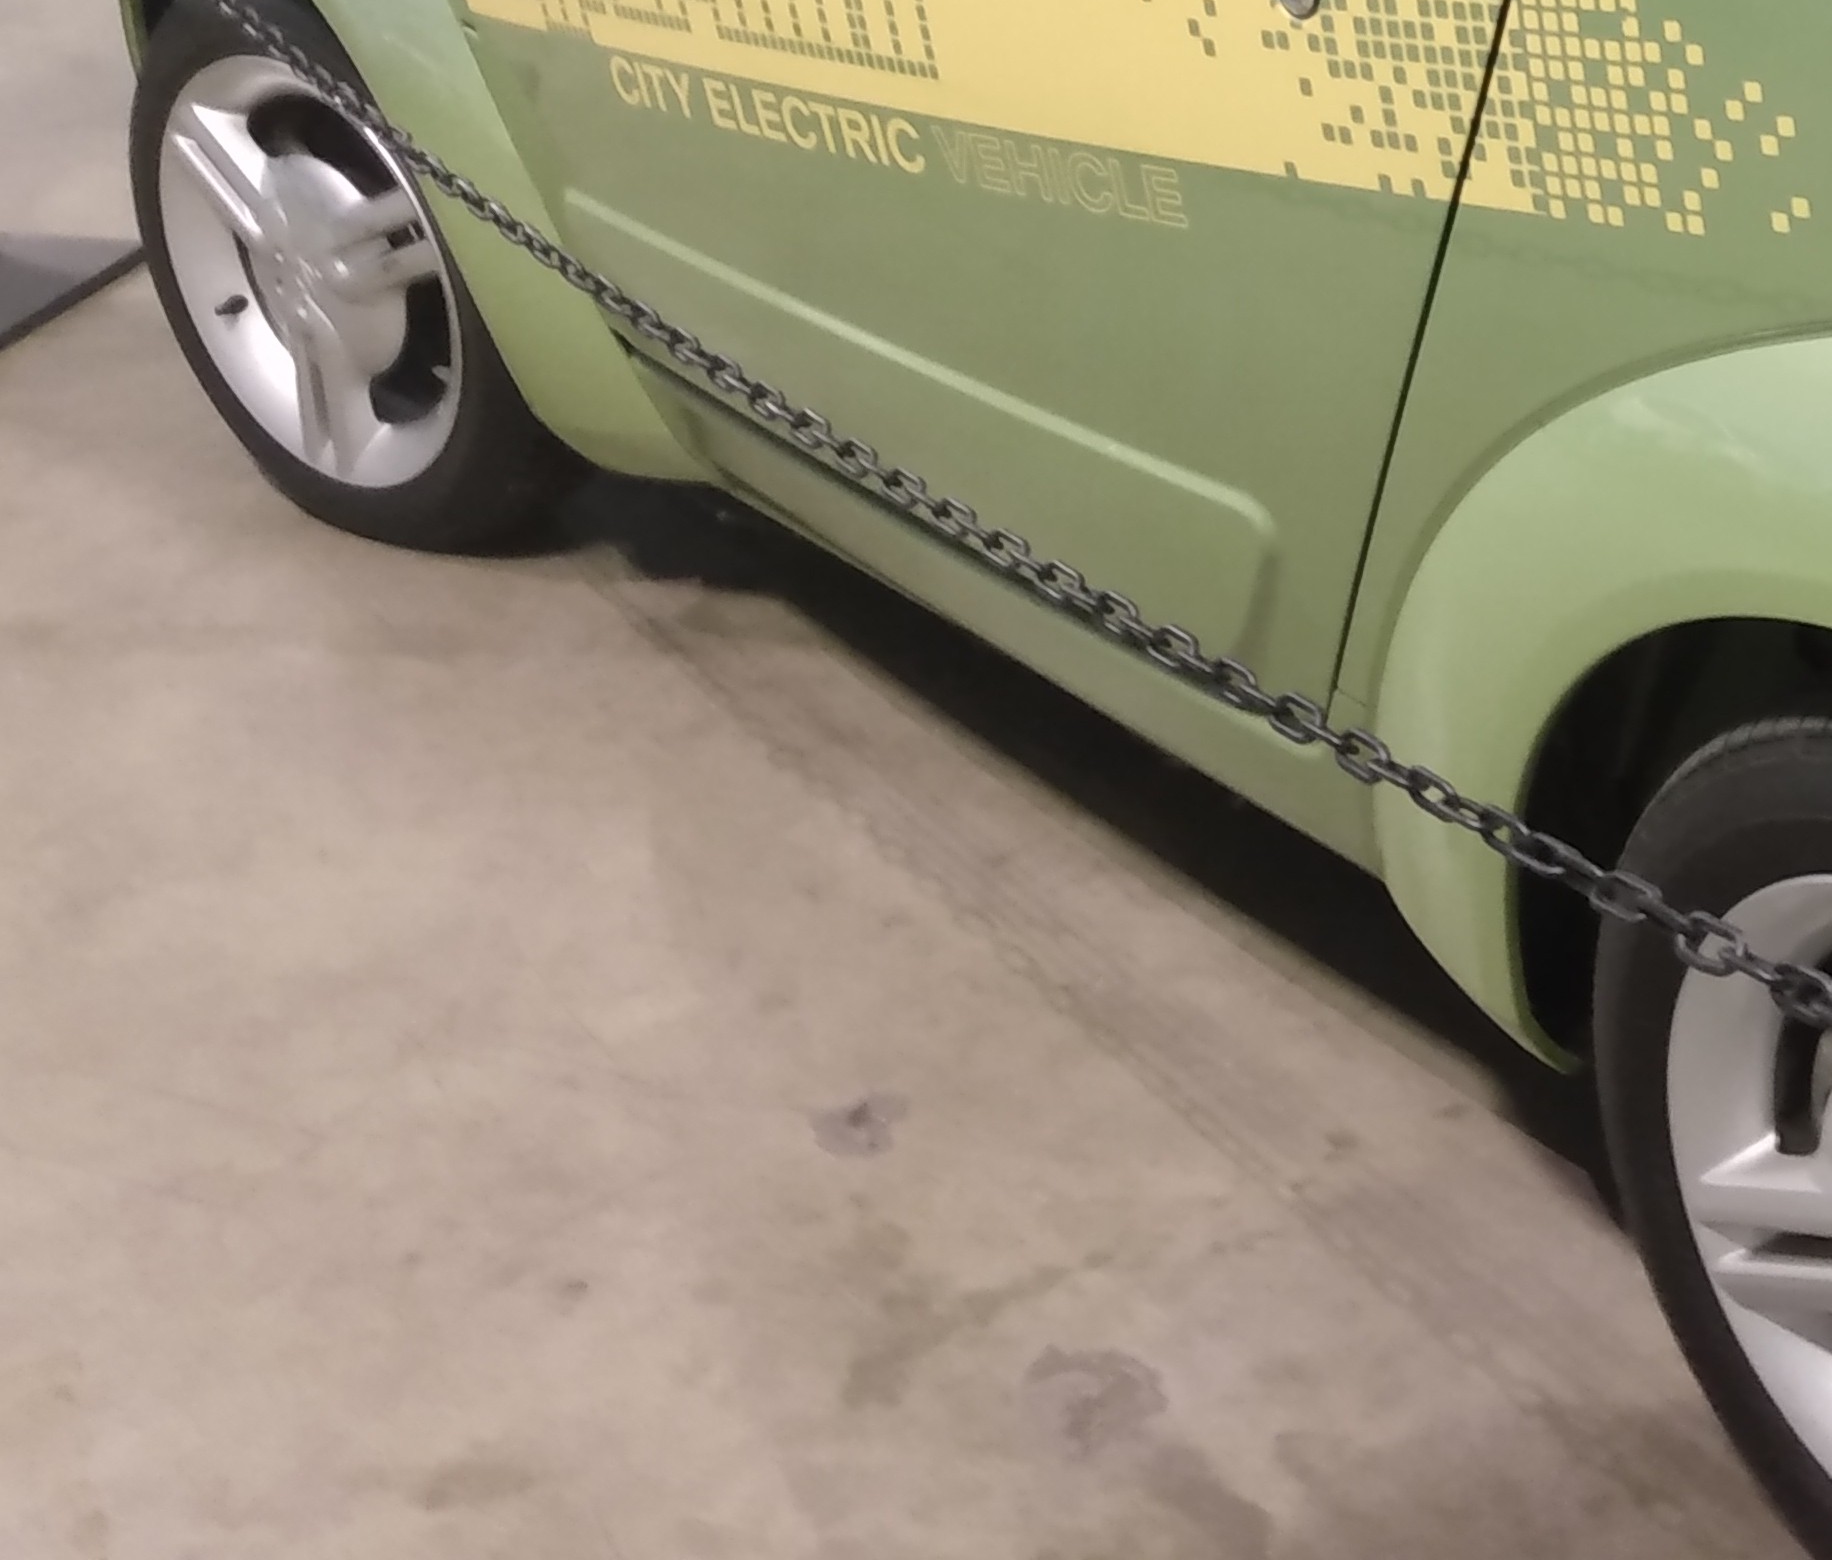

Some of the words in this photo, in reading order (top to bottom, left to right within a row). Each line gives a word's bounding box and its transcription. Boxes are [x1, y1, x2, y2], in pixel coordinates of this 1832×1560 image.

[608, 54, 693, 120] CITY
[702, 76, 926, 175] ELECTRIC
[931, 125, 1190, 229] VEHICLE
